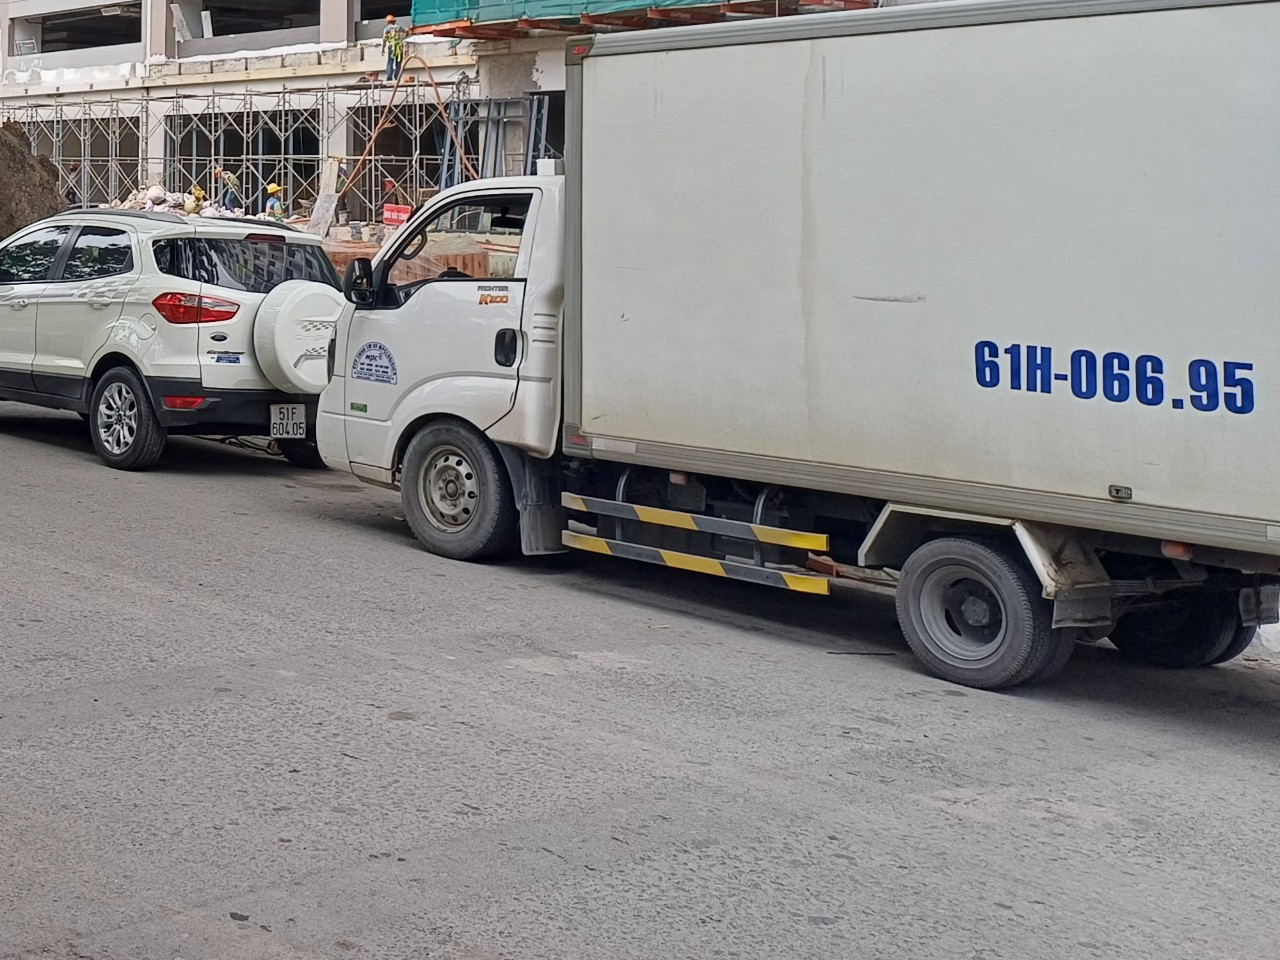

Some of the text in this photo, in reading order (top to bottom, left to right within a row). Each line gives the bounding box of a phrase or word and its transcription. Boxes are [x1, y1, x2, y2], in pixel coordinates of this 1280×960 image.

[974, 340, 1255, 414] 61H-066.95
[279, 407, 297, 421] 51F
[272, 422, 304, 436] 604.05
